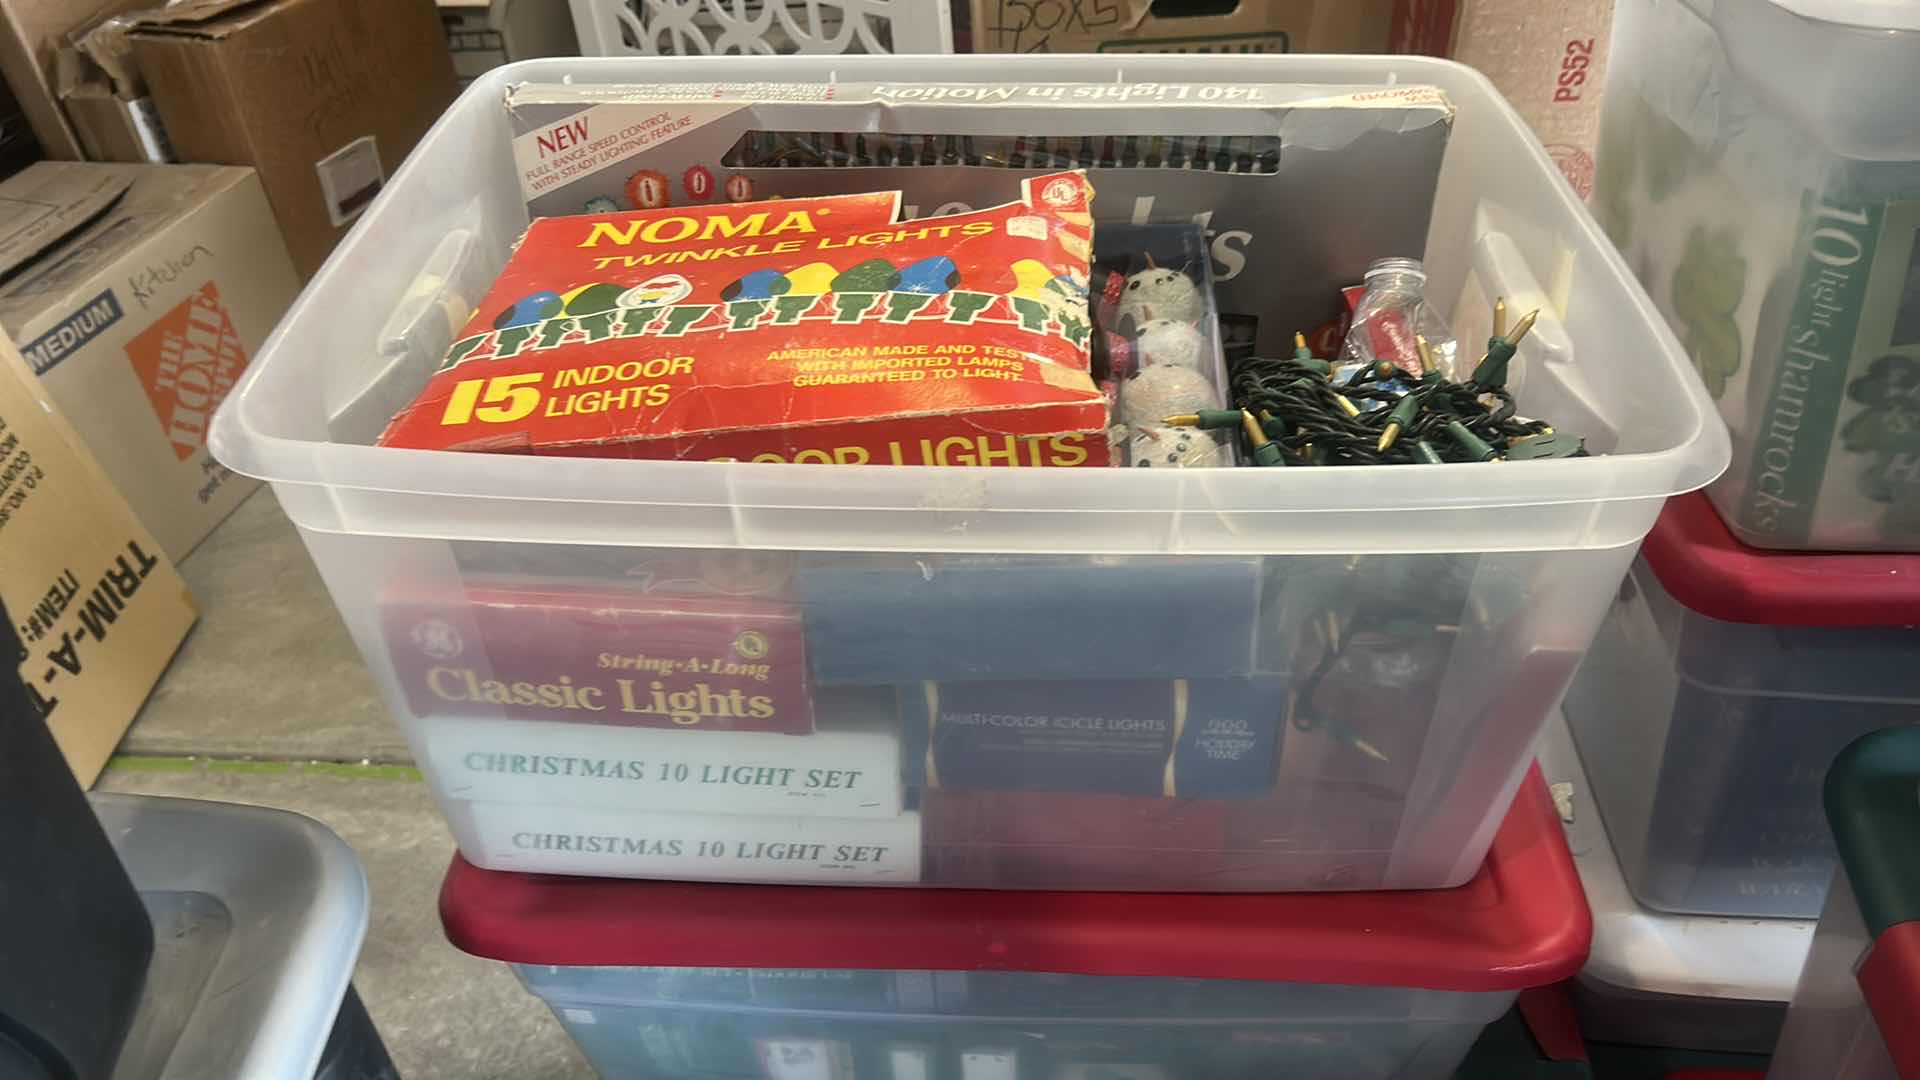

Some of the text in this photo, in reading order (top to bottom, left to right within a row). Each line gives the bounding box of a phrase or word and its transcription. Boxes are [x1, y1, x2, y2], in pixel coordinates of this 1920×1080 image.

[871, 82, 1265, 101] 140 Lights in Motion
[1552, 38, 1596, 104] PS52
[526, 111, 672, 181] FULL RANGE SPEED CONTROL
[531, 115, 695, 192] WITH STEADY LIGHTING FEATURE
[536, 116, 590, 159] NEW
[576, 210, 817, 248] NOMA
[593, 239, 808, 271] TWINKLE
[817, 220, 994, 251] LIGHTS
[24, 299, 114, 372] MEDIUM
[767, 346, 868, 362] AMERICAN
[873, 345, 930, 358] MADE
[934, 344, 977, 355] AND
[155, 329, 184, 391] THE
[170, 297, 223, 450] HOME
[792, 369, 926, 388] GUARANTEED
[931, 368, 959, 380] TO
[796, 356, 1025, 373] WITH IMPORTED LAMPS
[1757, 206, 1869, 532] 10 light shamrocks
[440, 356, 695, 426] 15 INDOOR
[544, 383, 671, 418] LIGHTS
[425, 665, 776, 726] Classic Lights
[1052, 717, 1105, 730] ICICLE
[1107, 718, 1168, 732] LIGHTS
[462, 751, 863, 790] CHRISTMAS 10 LIGHT SET
[512, 831, 889, 864] CHRISTMAS 10 LIGHT SET
